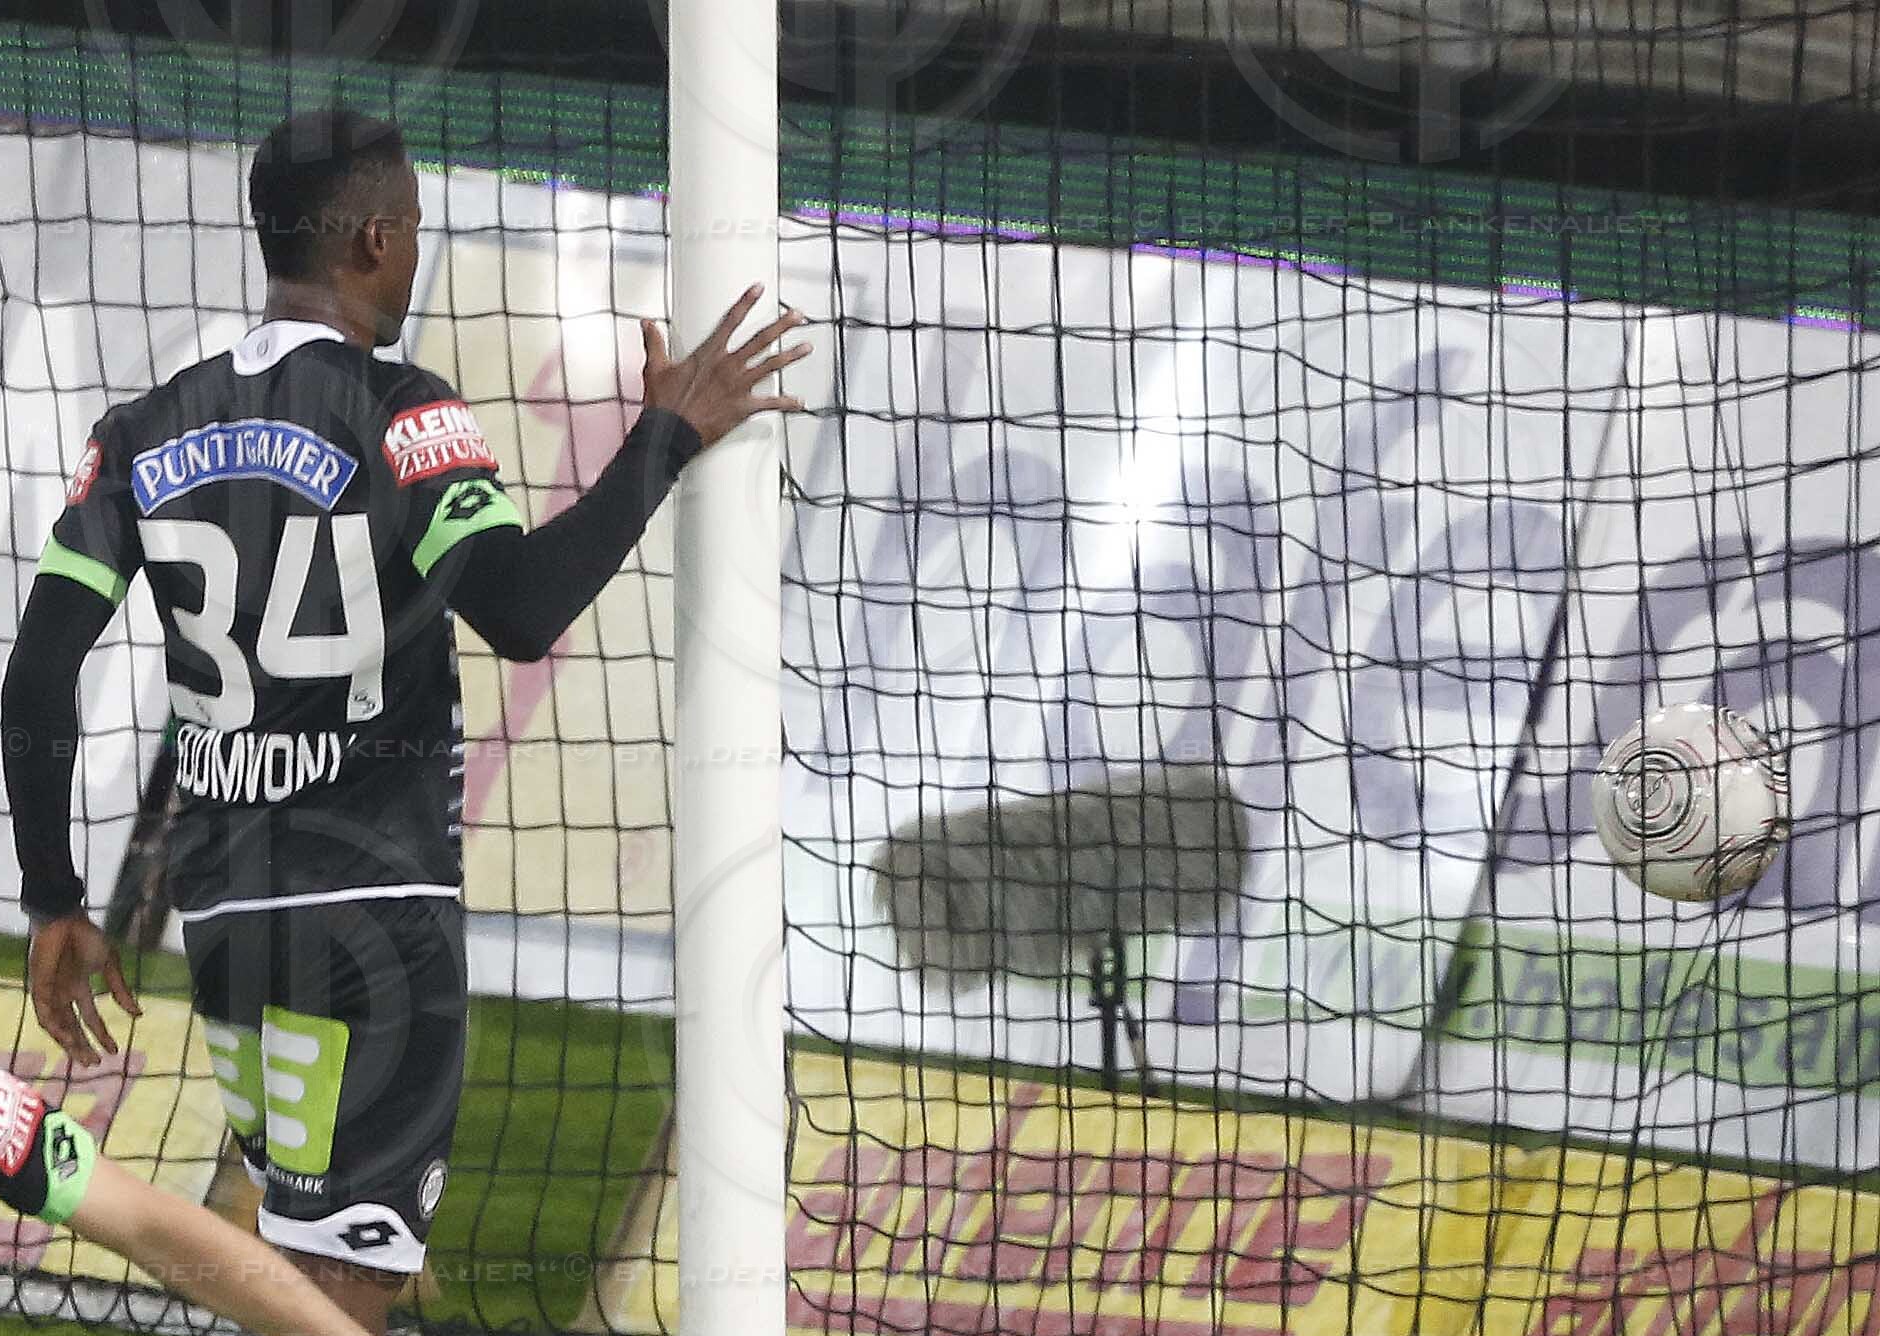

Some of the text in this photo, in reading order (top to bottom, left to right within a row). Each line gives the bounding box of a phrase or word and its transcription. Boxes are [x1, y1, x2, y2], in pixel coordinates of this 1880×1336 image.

[384, 405, 481, 453] KLEIN
[394, 437, 495, 480] ZEITUN
[136, 430, 341, 500] PUNTIGAMER
[137, 513, 386, 732] 34
